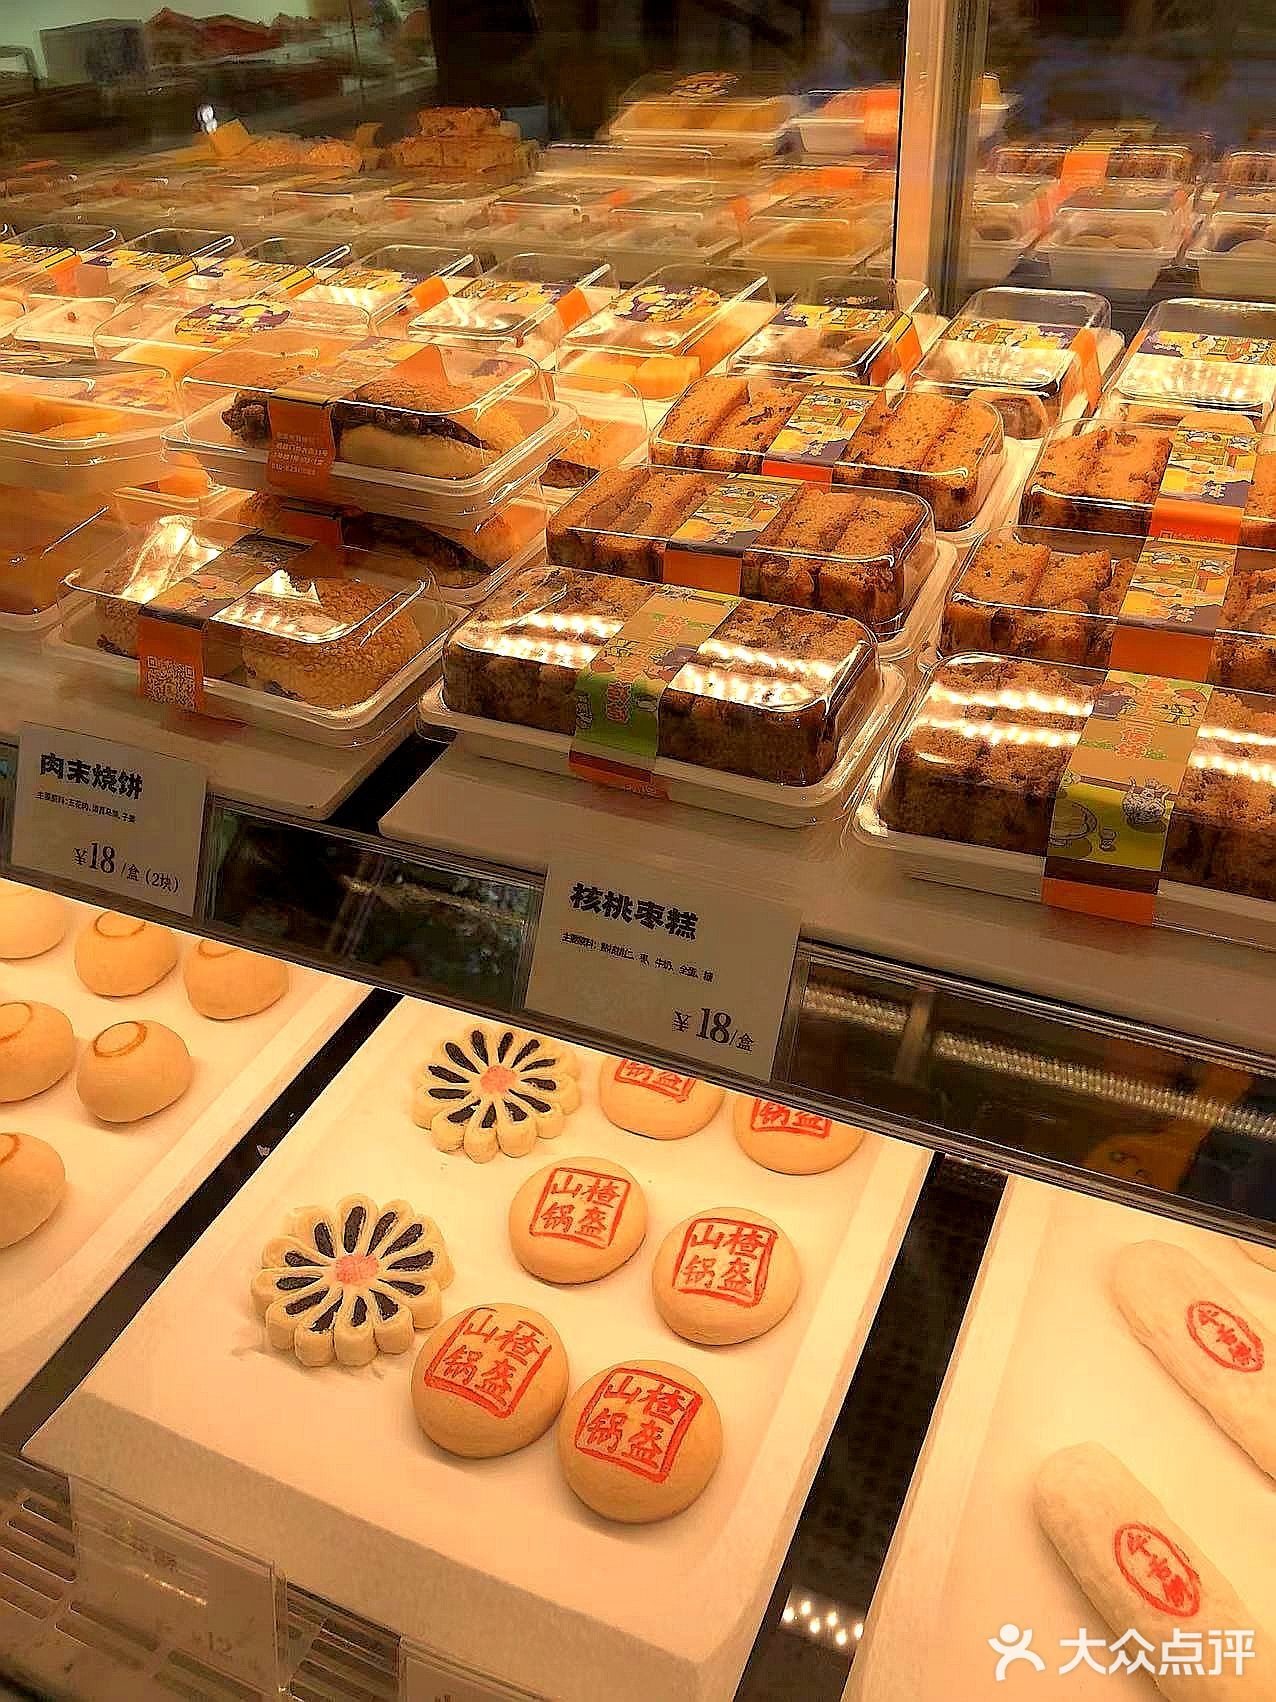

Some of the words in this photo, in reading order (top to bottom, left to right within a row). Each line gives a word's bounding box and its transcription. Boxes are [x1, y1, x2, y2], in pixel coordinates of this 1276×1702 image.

[40, 752, 143, 800] 肉末烧饼
[569, 882, 699, 940] 核桃枣糕
